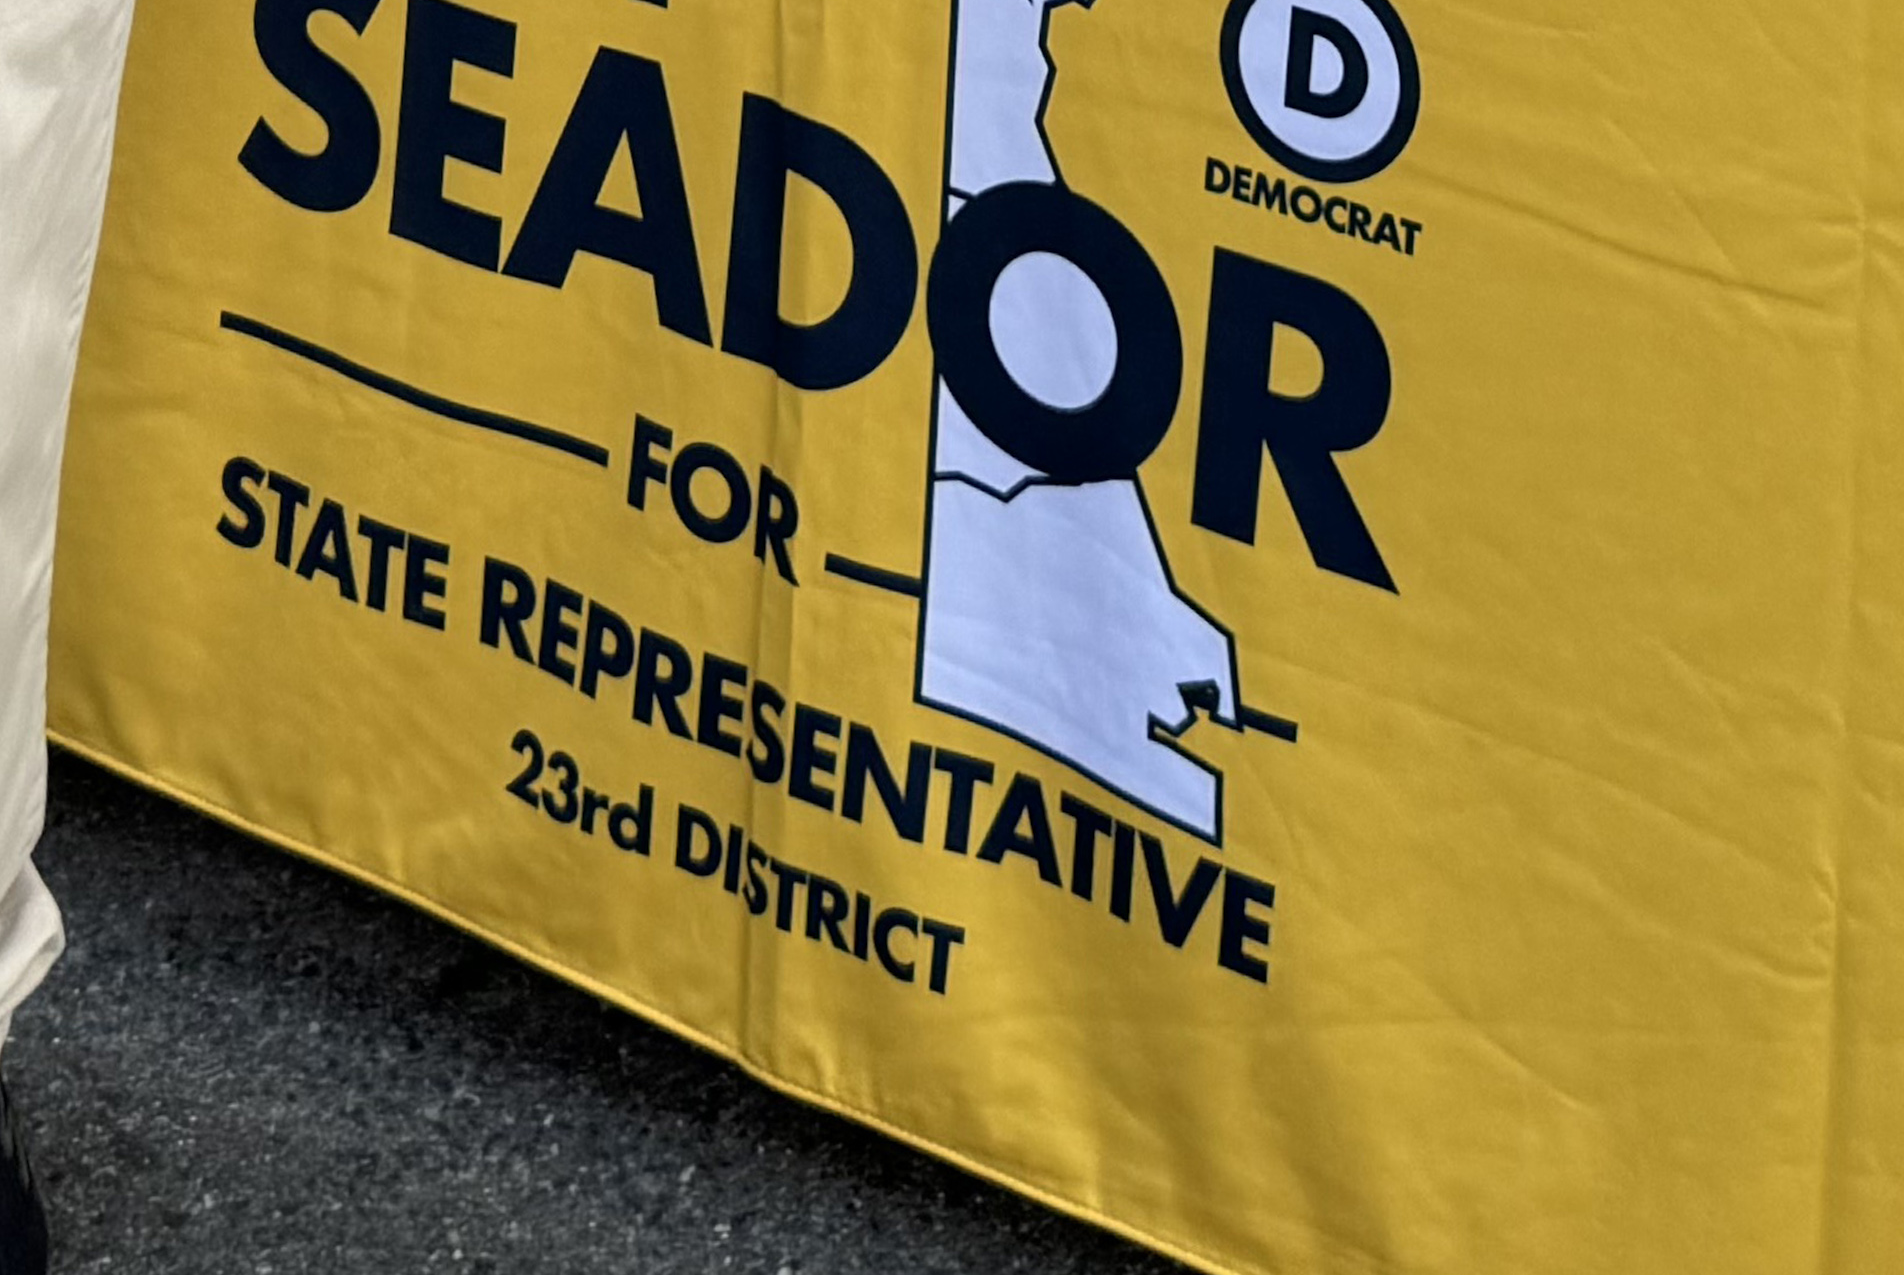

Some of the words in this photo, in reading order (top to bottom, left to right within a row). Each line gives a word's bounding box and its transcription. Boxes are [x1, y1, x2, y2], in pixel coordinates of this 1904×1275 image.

[1203, 155, 1423, 257] DEMOCRAT
[625, 413, 800, 588] FOR
[215, 455, 449, 632] STATE
[480, 555, 1277, 985] REPRESENTATIVE
[504, 729, 656, 857] 23rd
[675, 804, 965, 996] DISTRICT
